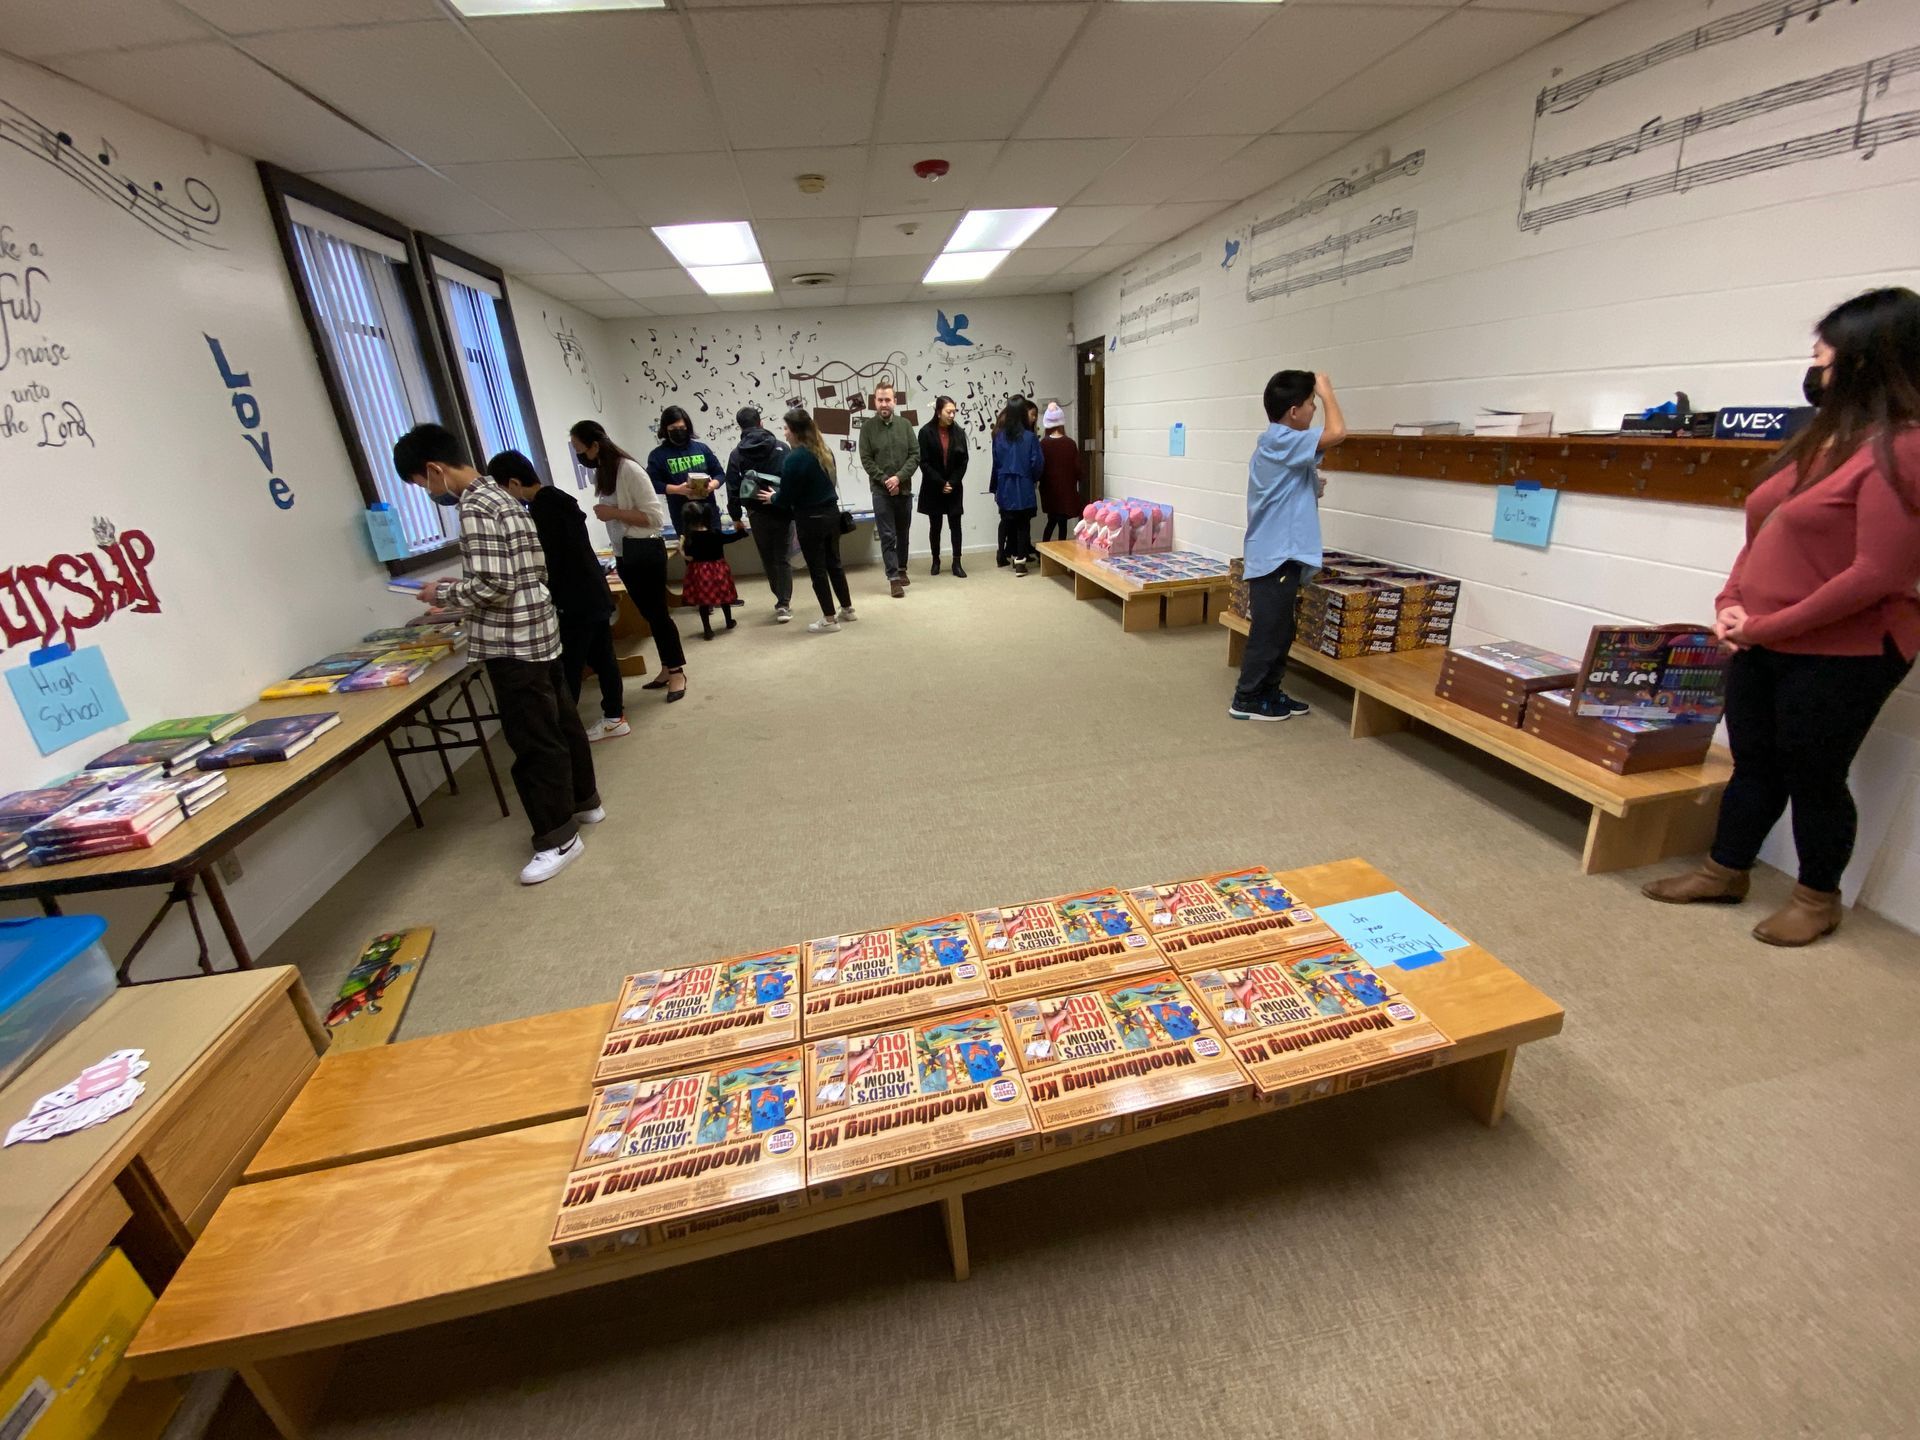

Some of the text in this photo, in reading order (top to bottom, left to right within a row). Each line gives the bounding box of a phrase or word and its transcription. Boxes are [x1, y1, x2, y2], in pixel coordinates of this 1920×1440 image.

[15, 336, 70, 366] noise
[12, 381, 50, 403] unto
[37, 401, 95, 447] Lord
[202, 331, 295, 510] Love
[1722, 412, 1785, 429] UVEX
[29, 666, 82, 696] High
[1589, 670, 1658, 685] art set
[39, 688, 104, 733] School
[1182, 904, 1218, 917] ROOM
[1020, 928, 1054, 941] ROOM
[1185, 915, 1294, 946] Woodburning
[1161, 938, 1187, 953] Kit
[1388, 934, 1443, 955] Middle
[851, 957, 886, 972] ROOM
[1014, 940, 1126, 973] Woodburning
[987, 964, 1011, 980] Kit
[834, 971, 952, 1007] Woodburning
[664, 994, 702, 1011] ROOM
[805, 997, 830, 1015] Kit
[1257, 996, 1300, 1013] ROOM
[1259, 1005, 1312, 1025] JARED'S
[1390, 1009, 1415, 1019] Classic
[633, 1010, 764, 1049] Woodburning
[1065, 1028, 1107, 1046] ROOM
[1265, 1012, 1395, 1055] Woodburning
[601, 1038, 632, 1057] Kit
[1062, 1038, 1116, 1059] JARED'S
[1196, 1044, 1220, 1055] Classic
[1237, 1043, 1269, 1064] Kit
[863, 1069, 905, 1089] ROOM
[1061, 1047, 1196, 1092] Woodburning
[857, 1081, 913, 1103] JARED'S
[992, 1087, 1017, 1099] Classic
[1029, 1079, 1058, 1102] Kit
[843, 1090, 987, 1140] Woodburning
[639, 1117, 686, 1140] ROOM
[808, 1126, 838, 1151] Kit
[627, 1130, 691, 1155] JARED'S
[768, 1138, 794, 1151] Classic
[600, 1141, 760, 1196] Woodburning
[561, 1180, 600, 1208] Kit
